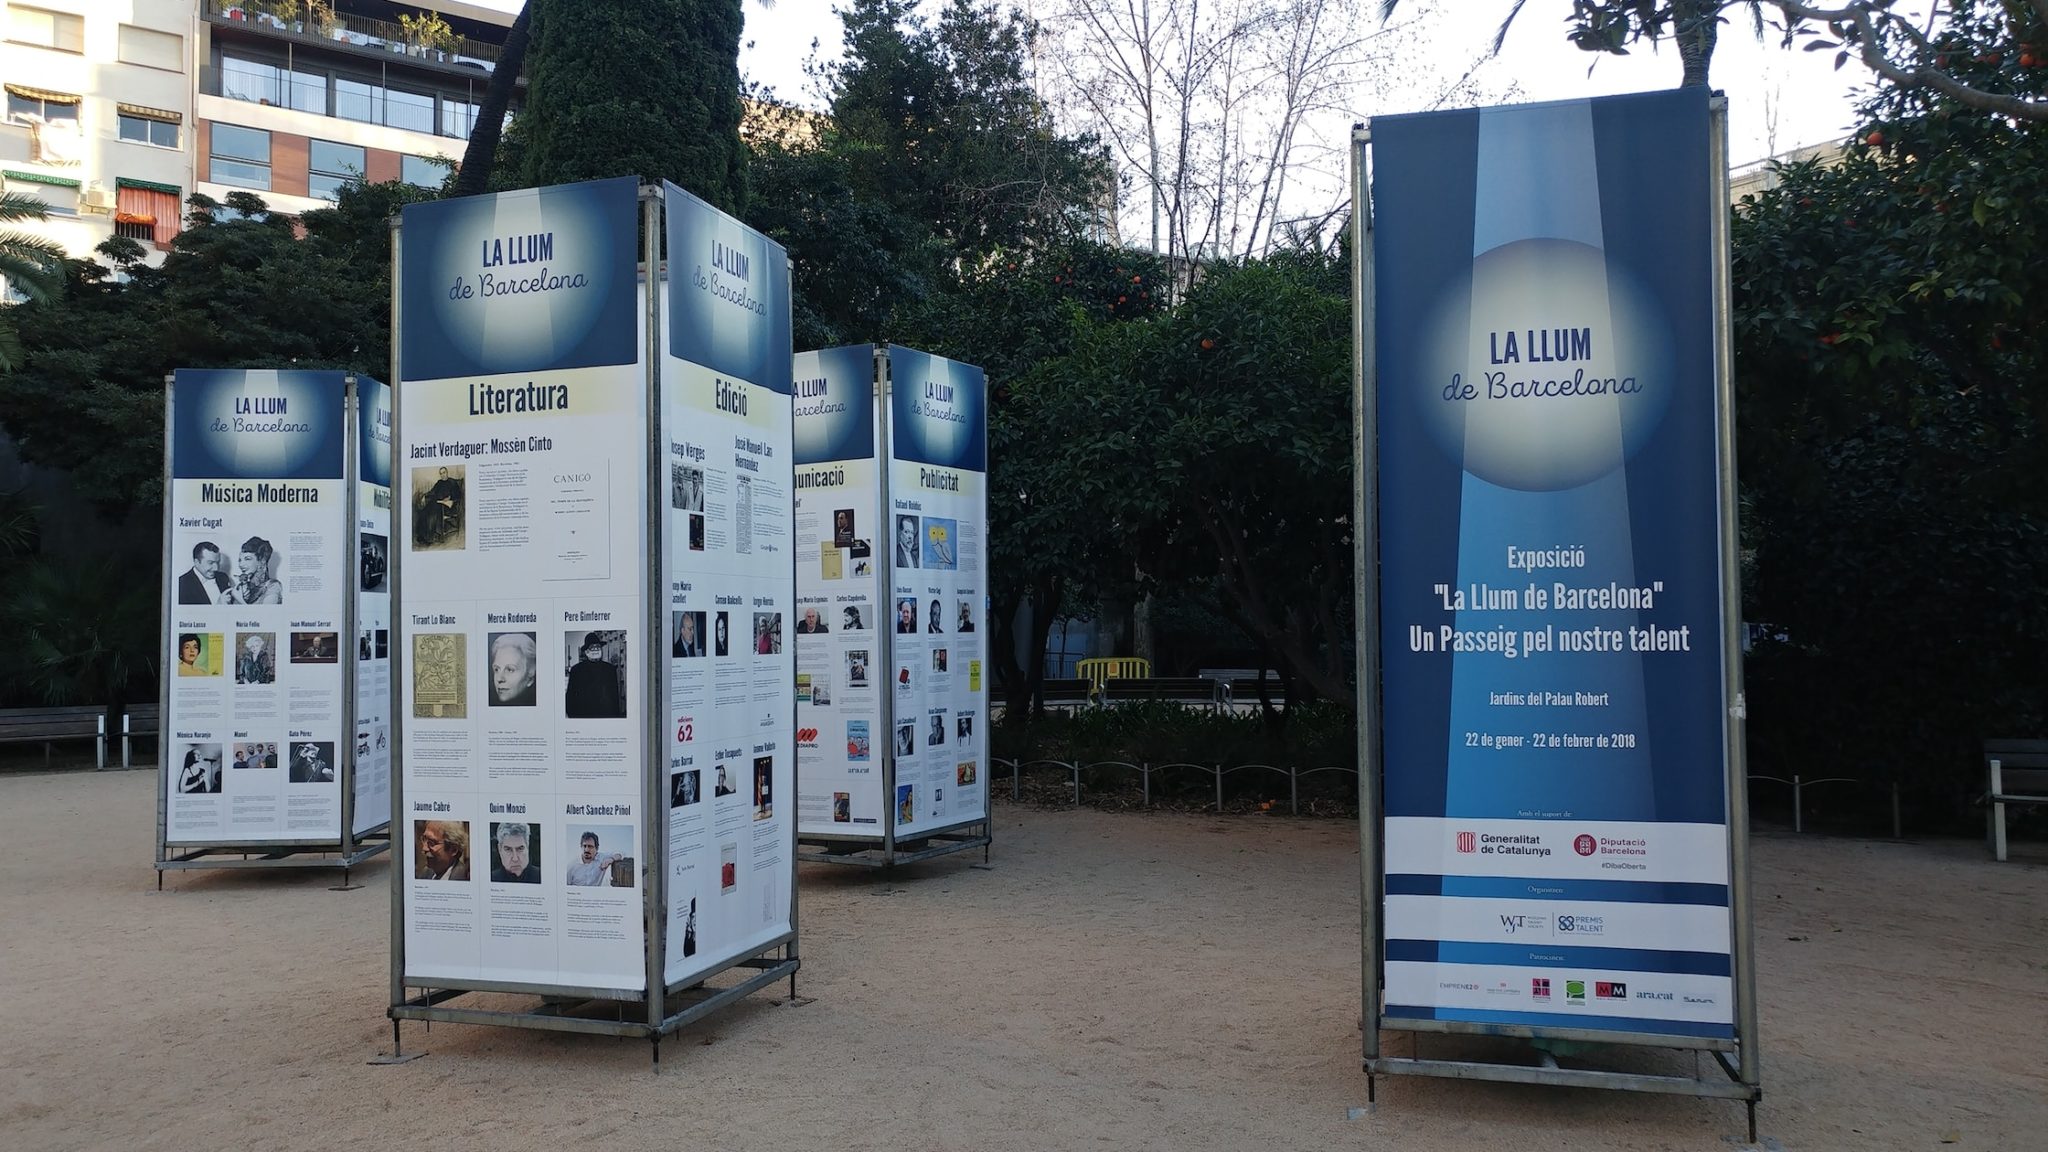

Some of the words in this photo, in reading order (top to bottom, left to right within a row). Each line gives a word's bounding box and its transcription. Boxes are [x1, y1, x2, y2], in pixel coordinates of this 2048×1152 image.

[483, 239, 503, 267] LA
[508, 233, 553, 264] LLUM
[712, 240, 723, 270] LA
[726, 247, 749, 282] LLUM
[449, 276, 475, 300] de
[479, 267, 589, 298] Barcelona
[692, 265, 708, 290] de
[709, 270, 767, 316] Barcelona
[1490, 331, 1520, 365] LA
[1528, 327, 1591, 363] LLUM
[793, 382, 799, 398] A
[802, 378, 828, 398] LLUM
[925, 381, 933, 399] LA
[935, 383, 954, 403] LLUM
[1442, 373, 1479, 401] de
[1484, 368, 1643, 400] Barcelona
[469, 381, 568, 416] Literatura
[716, 378, 747, 416] Edició
[235, 398, 251, 415] LA
[255, 397, 287, 415] LLUM
[795, 400, 848, 417] arcelona
[911, 399, 922, 416] de
[923, 401, 967, 424] Barcelona
[210, 416, 229, 433] de
[232, 417, 312, 433] Barcelona
[410, 442, 437, 459] Jacint
[438, 440, 488, 460] Verdaguer:
[490, 437, 526, 453] Mossèn
[528, 435, 553, 452] Cinto
[746, 437, 763, 455] Manuel
[794, 466, 844, 489] unicació
[920, 467, 959, 492] Publicitat
[202, 482, 253, 503] Música
[257, 482, 319, 503] Moderna
[179, 517, 201, 528] Xavier
[202, 517, 223, 528] Cugat
[1507, 545, 1585, 573] Exposició
[1434, 584, 1465, 611] "La
[1471, 583, 1518, 610] Llum
[1524, 582, 1548, 610] de
[1553, 581, 1664, 610] Barcelona"
[317, 620, 332, 628] Serrat
[412, 614, 431, 626] Tirant
[431, 615, 439, 625] Lo
[439, 614, 456, 625] Blanc
[507, 612, 537, 624] Rodoreda
[564, 611, 579, 622] Pere
[579, 610, 611, 622] Gimferrer
[1409, 625, 1434, 652] Un
[1440, 625, 1518, 658] Passeig
[1523, 624, 1553, 658] pel
[1559, 626, 1623, 652] nostre
[1628, 624, 1690, 652] talent
[1489, 691, 1525, 706] Jardins
[1527, 691, 1543, 706] del
[1545, 692, 1573, 706] Palau
[1575, 691, 1609, 706] Robert
[194, 731, 211, 739] Naranjo
[677, 724, 694, 742] 62
[1465, 733, 1478, 747] 22
[1481, 733, 1493, 747] de
[1495, 735, 1524, 749] gener
[1533, 733, 1546, 747] 22
[1548, 733, 1561, 747] de
[1563, 733, 1594, 748] febrer
[1597, 733, 1609, 748] de
[1611, 733, 1635, 748] 2018
[413, 801, 432, 812] Jaume
[433, 801, 450, 812] Cabré
[489, 802, 505, 814] Quim
[506, 802, 526, 814] Monzó
[566, 804, 585, 815] Albert
[614, 804, 631, 816] Piñol
[1517, 809, 1534, 817] Amb
[1481, 834, 1540, 844] Generalitat
[1600, 837, 1646, 847] Diputació
[1481, 845, 1494, 854] de
[1497, 845, 1551, 857] Catalunya
[1600, 846, 1646, 856] Barcelona
[1601, 862, 1647, 870] #DibaOberta
[1575, 916, 1604, 924] PREMIS
[1575, 924, 1604, 932] TALENT
[1636, 991, 1674, 1000] ara.cat
